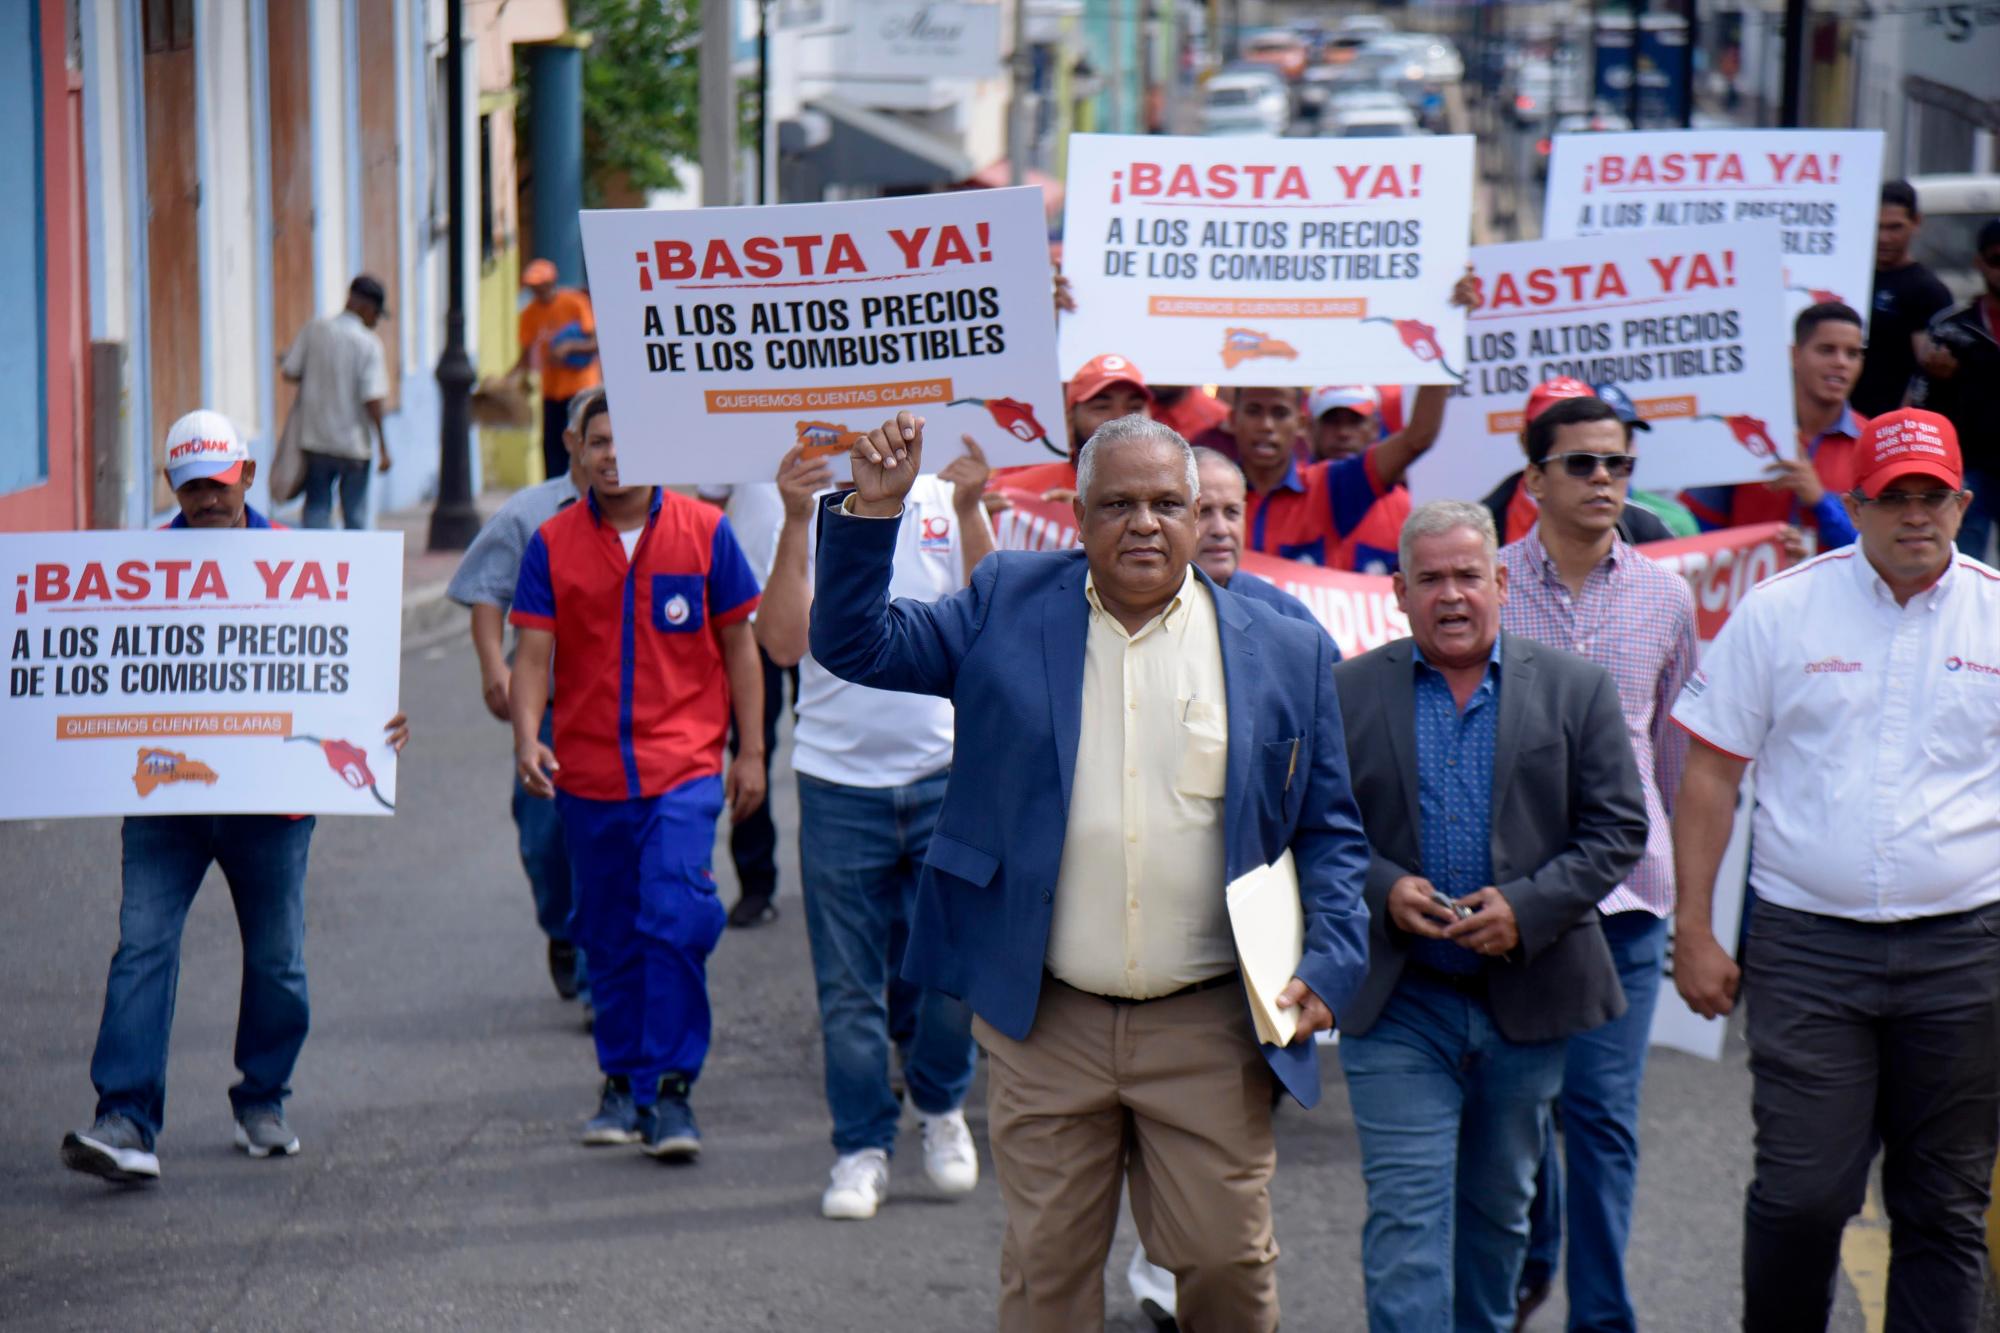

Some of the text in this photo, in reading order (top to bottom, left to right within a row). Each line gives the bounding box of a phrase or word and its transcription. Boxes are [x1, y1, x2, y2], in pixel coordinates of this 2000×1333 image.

[1111, 162, 1423, 205] ¡BASTA YA!
[1583, 153, 1841, 193] ¡BASTA YA!
[1578, 204, 1592, 226] A
[1601, 203, 1645, 227] LOS
[1653, 201, 1725, 226] ALTOS
[1107, 218, 1420, 249] A LOS ALTOS PRECIOS
[635, 221, 993, 292] ¡BASTA YA!
[1104, 250, 1420, 281] DE LOS COMBUSTIBLES
[1649, 250, 1735, 293] YA!
[643, 286, 999, 337] A LOS ALTOS PRECIOS
[647, 324, 1006, 373] DE LOS COMBUSTIBLES
[1466, 310, 1740, 363] LOS ALTOS PRECIOS
[715, 383, 943, 409] QUEREMOS CUENTAS CLARAS
[1481, 365, 1529, 396] LOS
[15, 560, 350, 614] ¡BASTA YA!
[12, 624, 349, 660] A LOS ALTOS PRECIOS
[10, 662, 349, 697] DE LOS COMBUSTIBLES
[66, 716, 282, 735] QUEREMOS CUENTAS CLARAS
